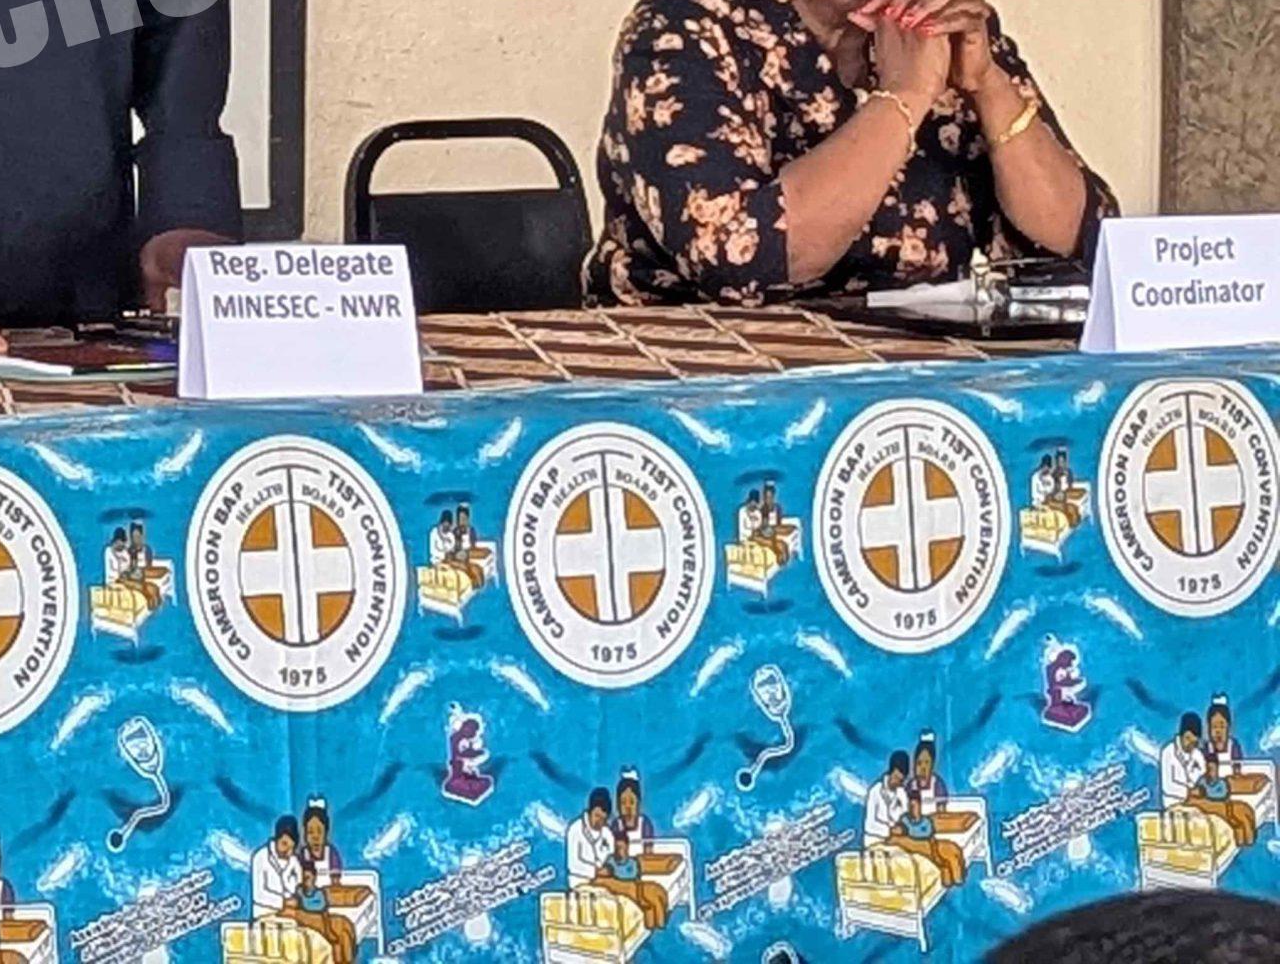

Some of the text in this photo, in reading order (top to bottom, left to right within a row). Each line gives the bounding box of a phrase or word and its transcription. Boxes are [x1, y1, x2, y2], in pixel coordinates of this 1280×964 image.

[209, 248, 393, 282] Reg. Delegate
[1155, 236, 1235, 267] Project
[212, 294, 320, 320] MINESEC
[340, 294, 403, 319] NWR
[1131, 279, 1266, 307] Coordinator
[1115, 394, 1271, 572] CAMEROON BAP TIST CONVENTION
[829, 427, 992, 610] CAMEROON BAP TIST CONVENTION
[523, 455, 695, 639] CAMEROON BAP TIST CONVENTION
[205, 471, 386, 663] CAMEROON BAP TIST CONVENTION
[1177, 573, 1221, 594] 1975
[14, 533, 57, 689] CONVENTION
[894, 611, 936, 630] 1975
[591, 644, 637, 662] 1975
[279, 668, 327, 686] 1975
